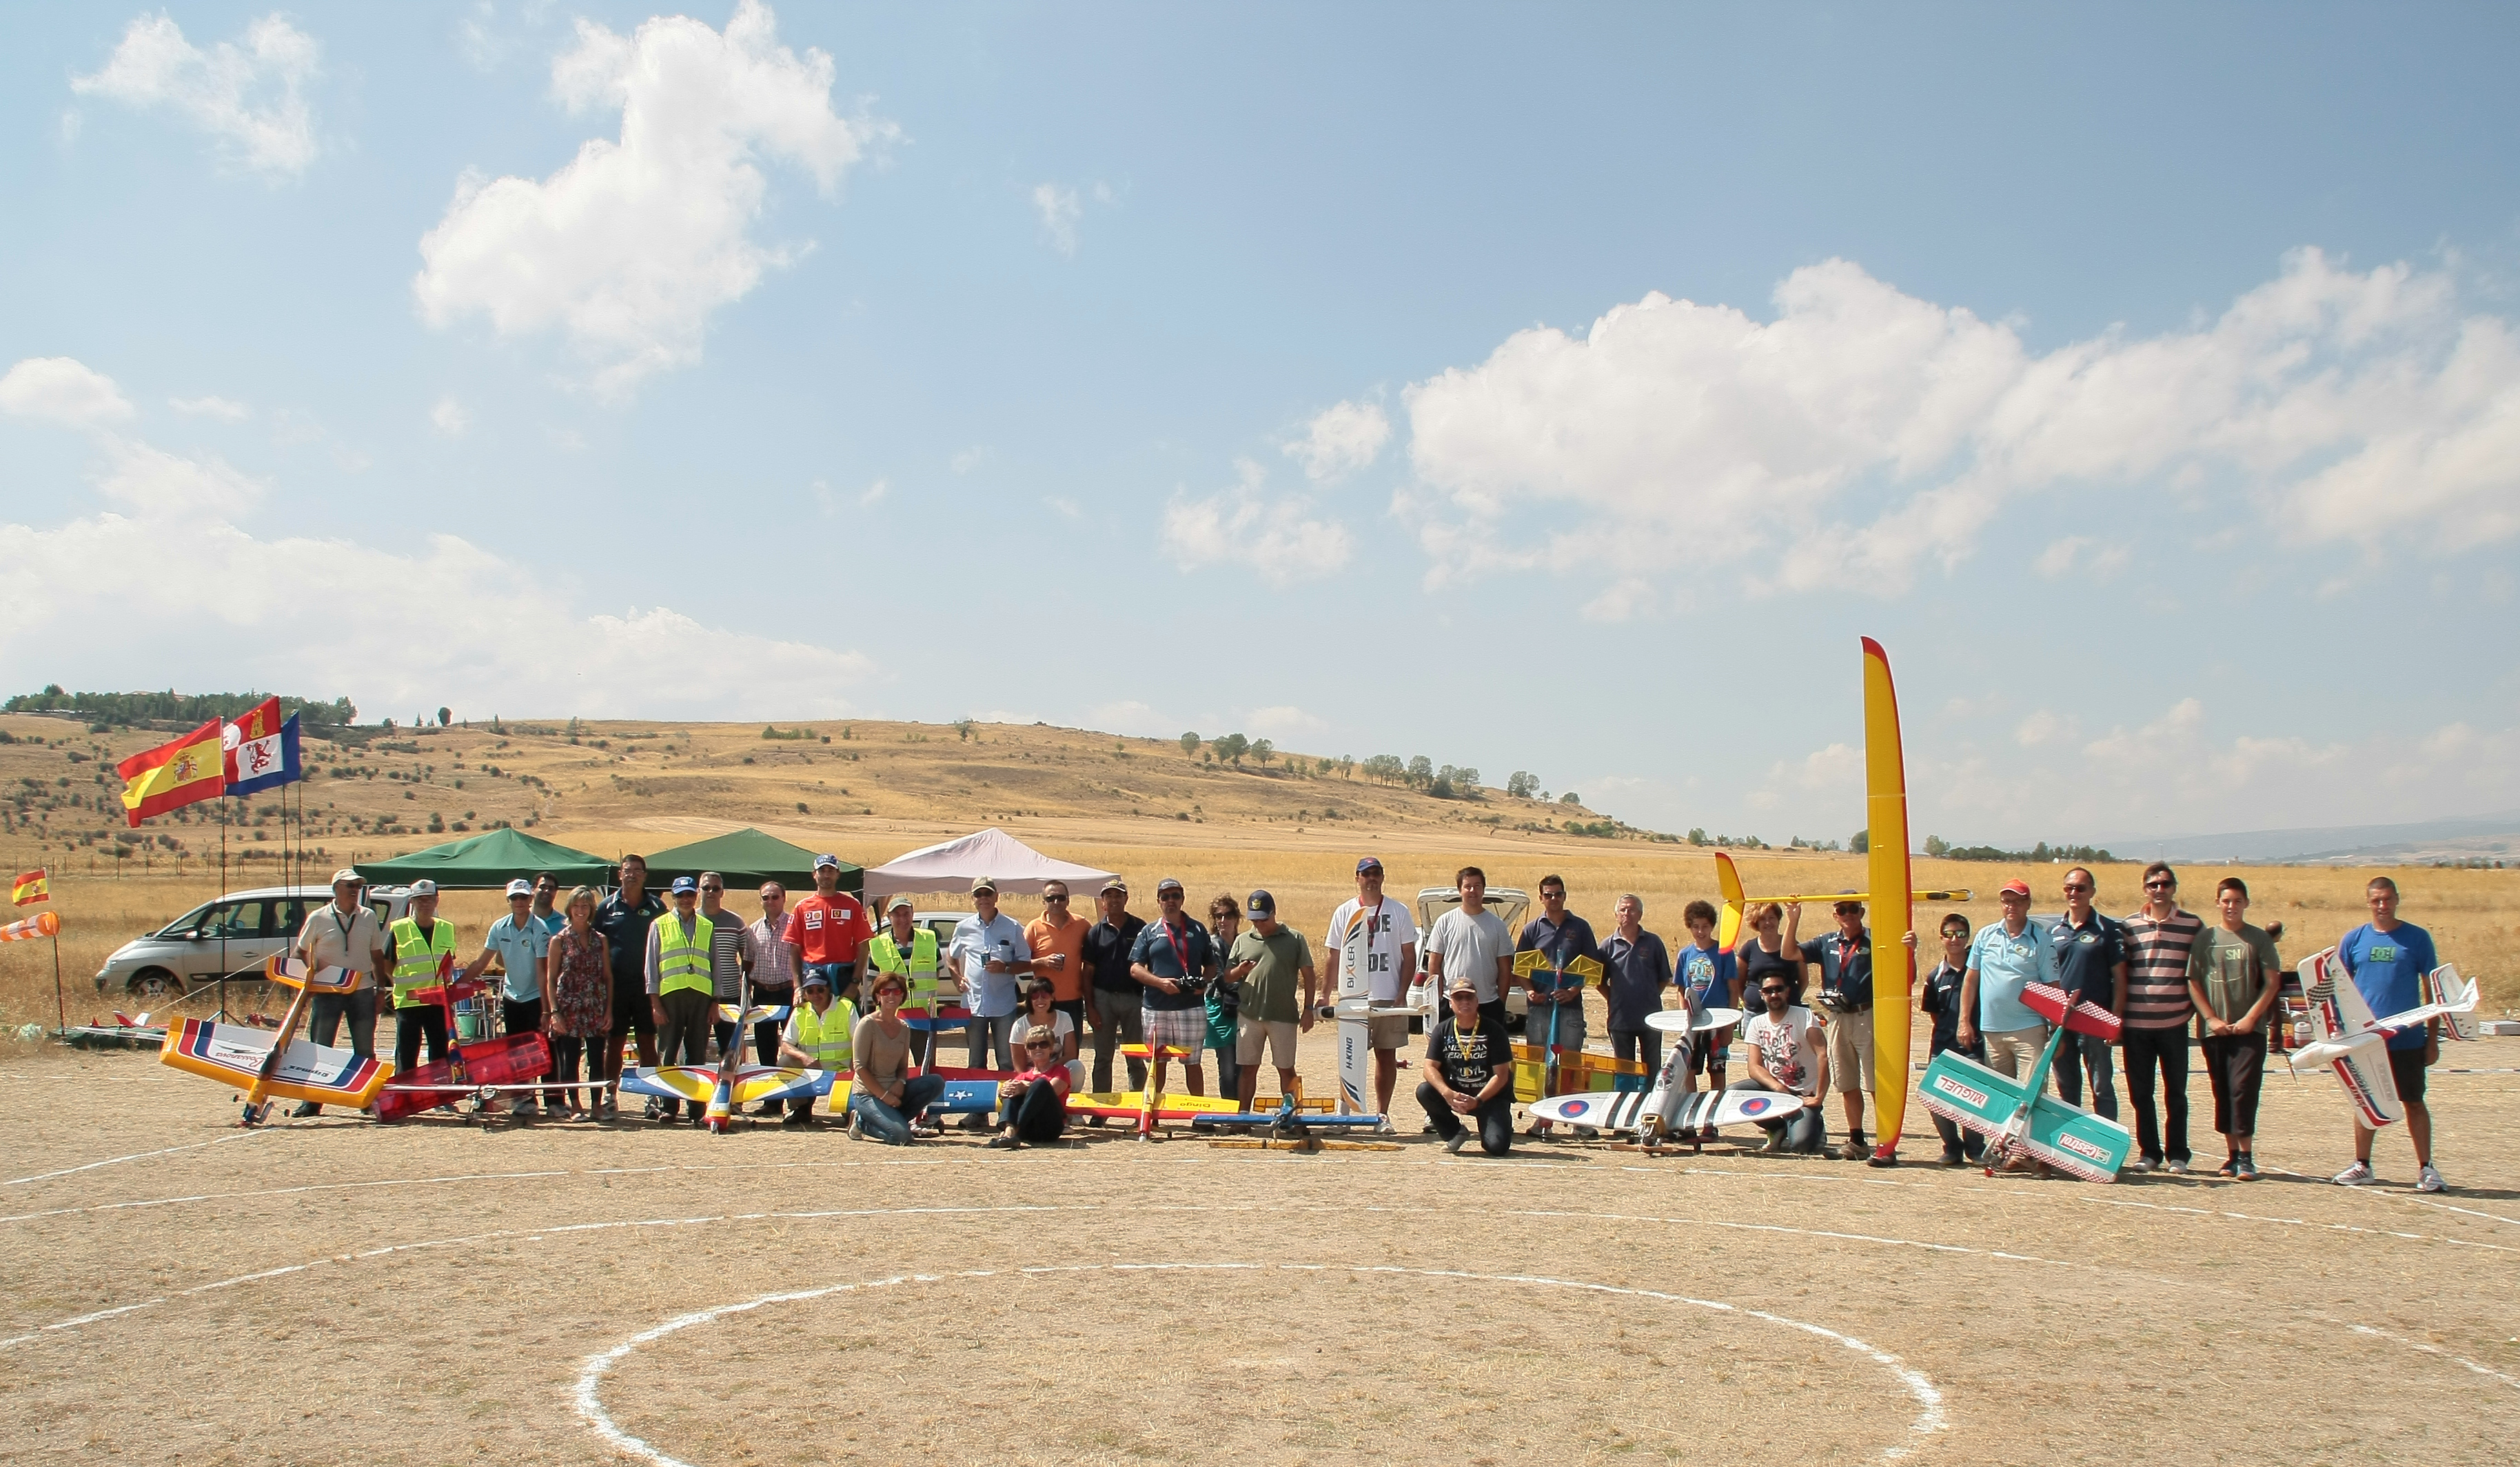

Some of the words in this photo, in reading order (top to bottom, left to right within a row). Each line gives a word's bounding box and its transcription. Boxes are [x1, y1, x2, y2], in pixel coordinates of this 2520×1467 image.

[1346, 946, 1357, 988] BIXLER
[215, 1052, 266, 1067] Bossanova
[1445, 1051, 1487, 1059] ERIAGE
[1940, 1076, 1986, 1106] MIGUEL
[2060, 1135, 2097, 1157] Castrol
